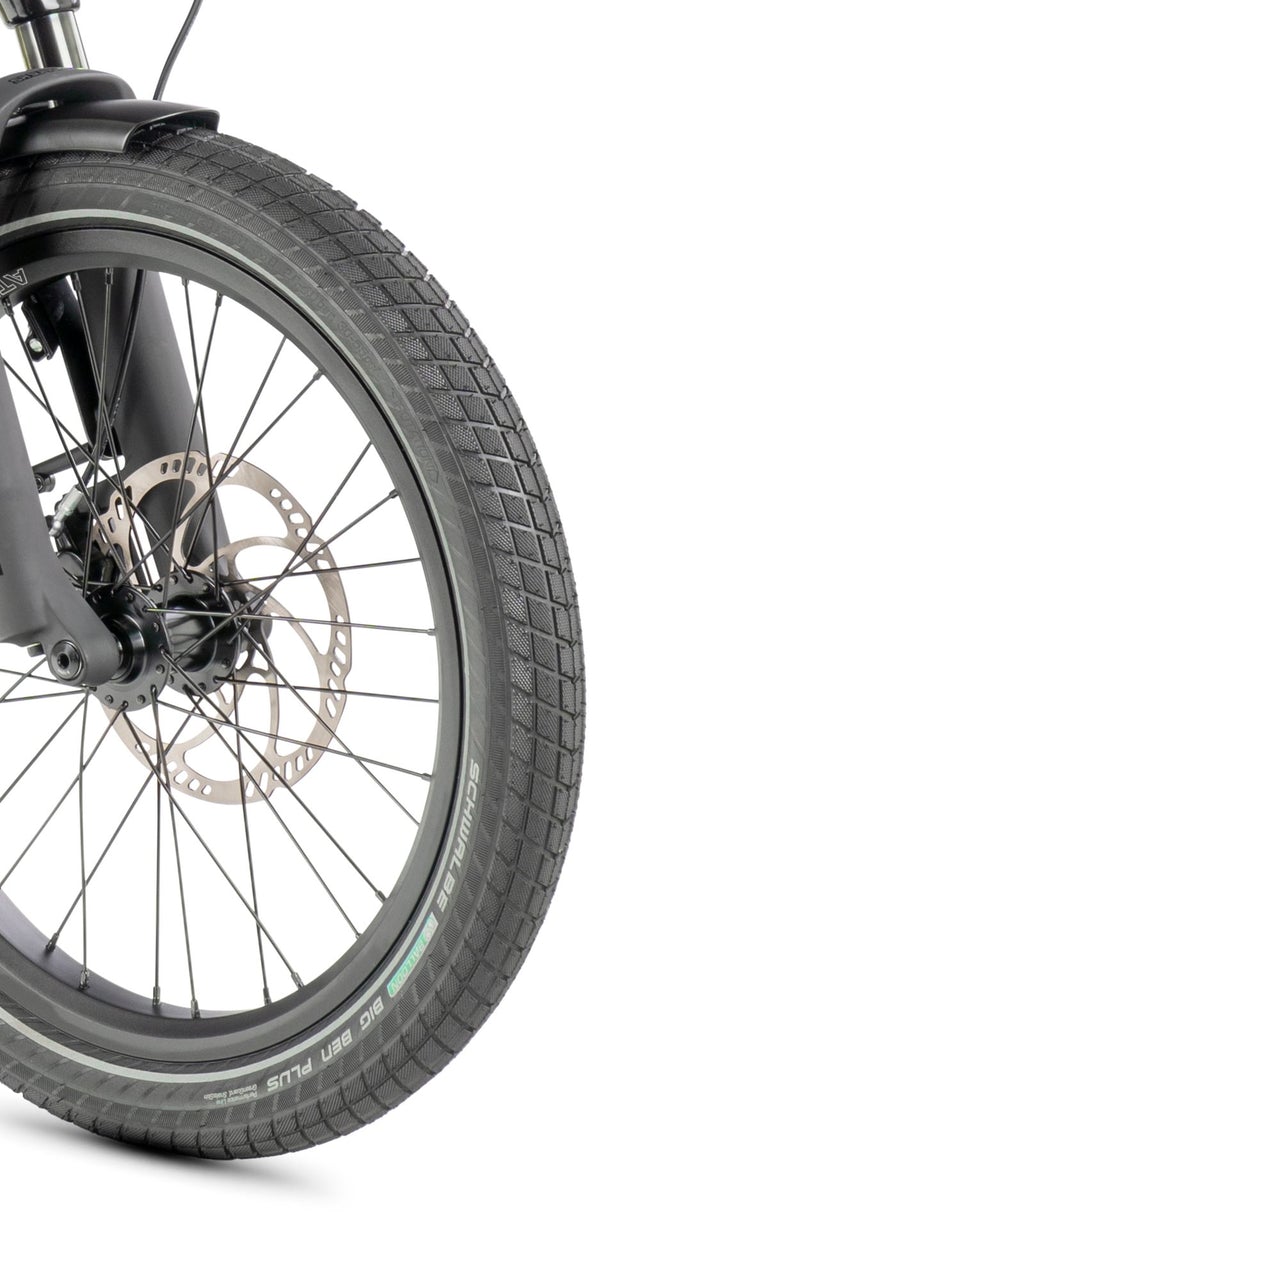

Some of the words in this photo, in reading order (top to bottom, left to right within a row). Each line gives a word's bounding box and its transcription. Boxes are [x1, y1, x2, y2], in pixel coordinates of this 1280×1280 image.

[437, 759, 480, 913] SCHWALBE
[359, 996, 385, 1031] BIG
[267, 1057, 312, 1092] PLUS
